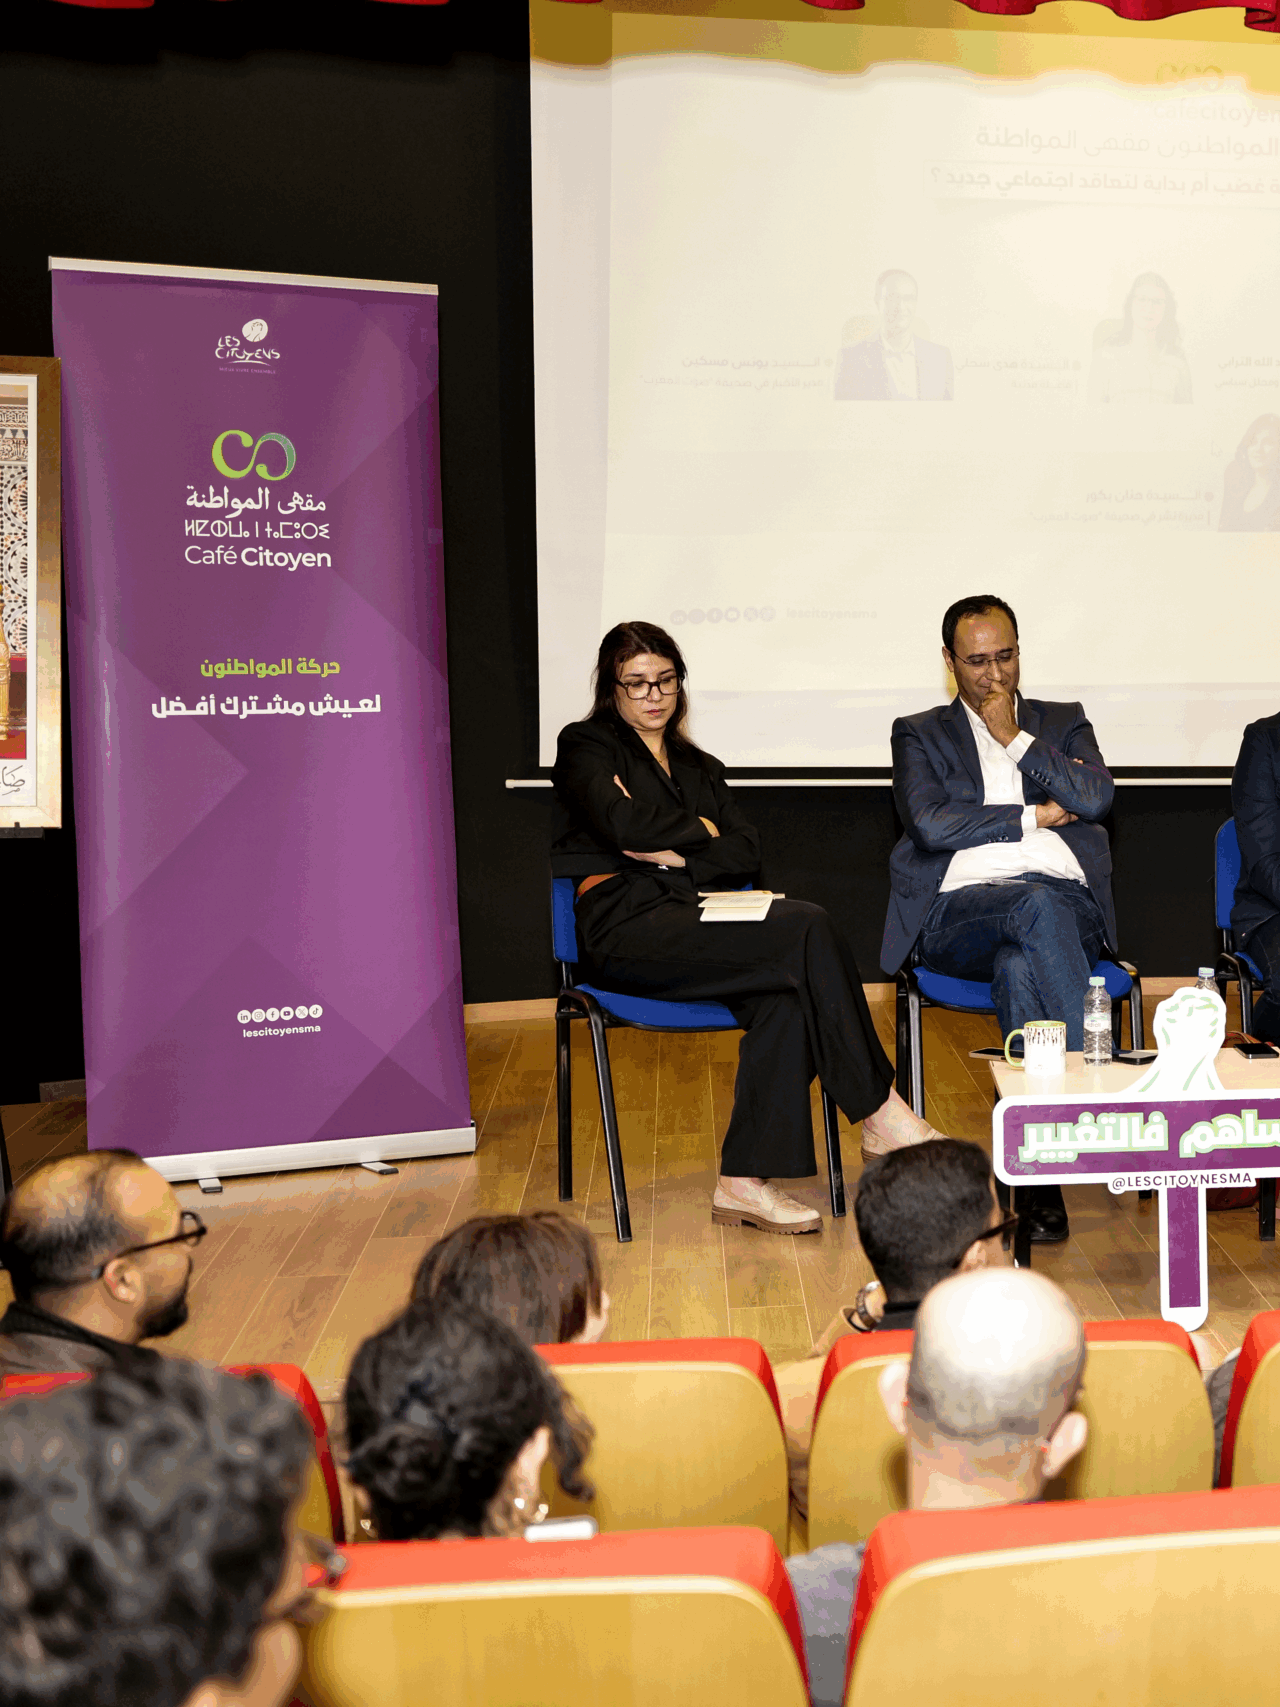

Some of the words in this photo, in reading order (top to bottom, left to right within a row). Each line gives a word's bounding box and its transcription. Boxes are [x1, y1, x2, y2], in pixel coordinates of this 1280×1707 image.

[218, 335, 241, 348] LES
[186, 485, 271, 519] المواطنة
[277, 491, 326, 515] مقهى
[184, 545, 238, 565] Café
[241, 546, 332, 572] Citoyen
[200, 658, 293, 679] المواطنون
[296, 657, 341, 678] حركة
[151, 693, 216, 719] أفضل
[220, 693, 306, 720] مشترك
[308, 693, 382, 719] لعيش
[243, 1025, 321, 1038] lescitoyensma
[1018, 1110, 1169, 1163] فالتغيير
[1112, 1172, 1252, 1190] @LESCITOYNESMA
